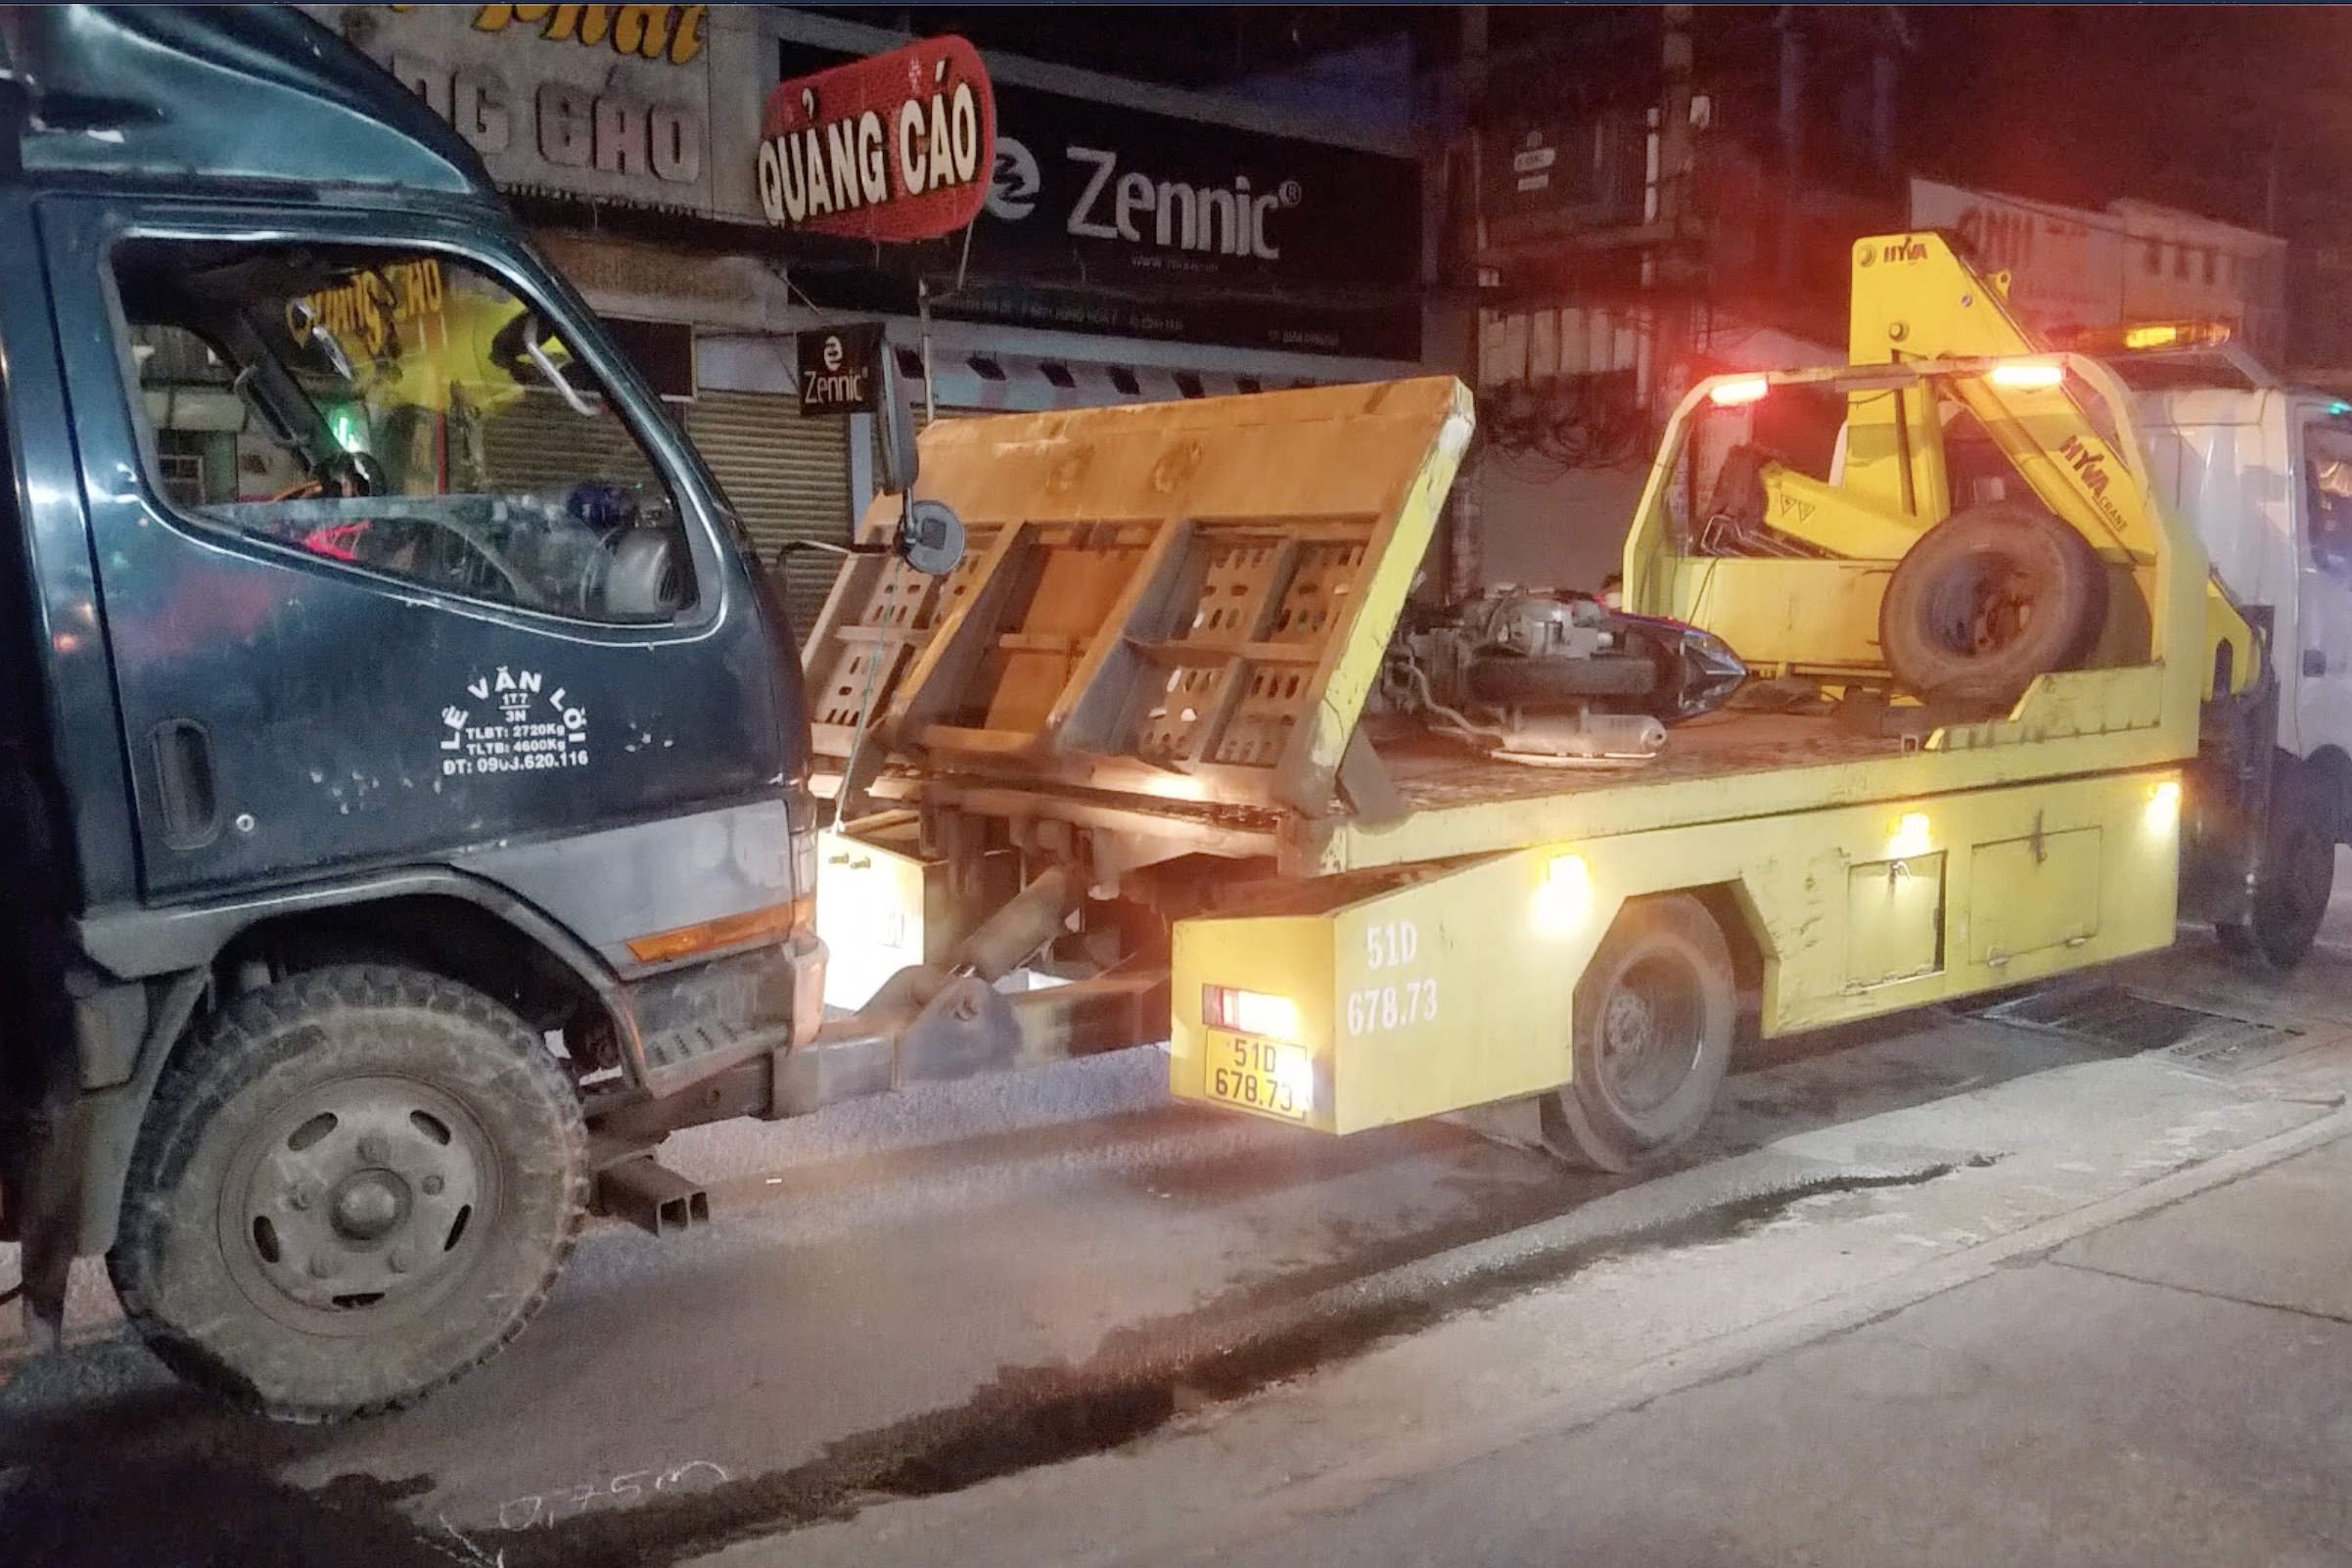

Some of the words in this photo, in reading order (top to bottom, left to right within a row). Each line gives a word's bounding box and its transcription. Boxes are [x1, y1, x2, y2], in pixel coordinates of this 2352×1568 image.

[759, 88, 887, 227] QUẢNG
[899, 61, 976, 196] CÁO
[1883, 237, 1927, 262] HYVA
[2059, 435, 2111, 497] HYVA
[2098, 495, 2129, 531] CRANE
[440, 704, 469, 750] LÊ
[467, 666, 542, 701] VĂN
[506, 711, 527, 722] 3N
[466, 727, 508, 740] TLBT:
[513, 723, 565, 737] 2720Kg
[513, 739, 566, 753] 4600Kg
[1366, 921, 1417, 970] 51D
[1347, 979, 1438, 1037] 678.73
[1234, 1038, 1276, 1073] 51D
[1216, 1068, 1293, 1112] 678.73
